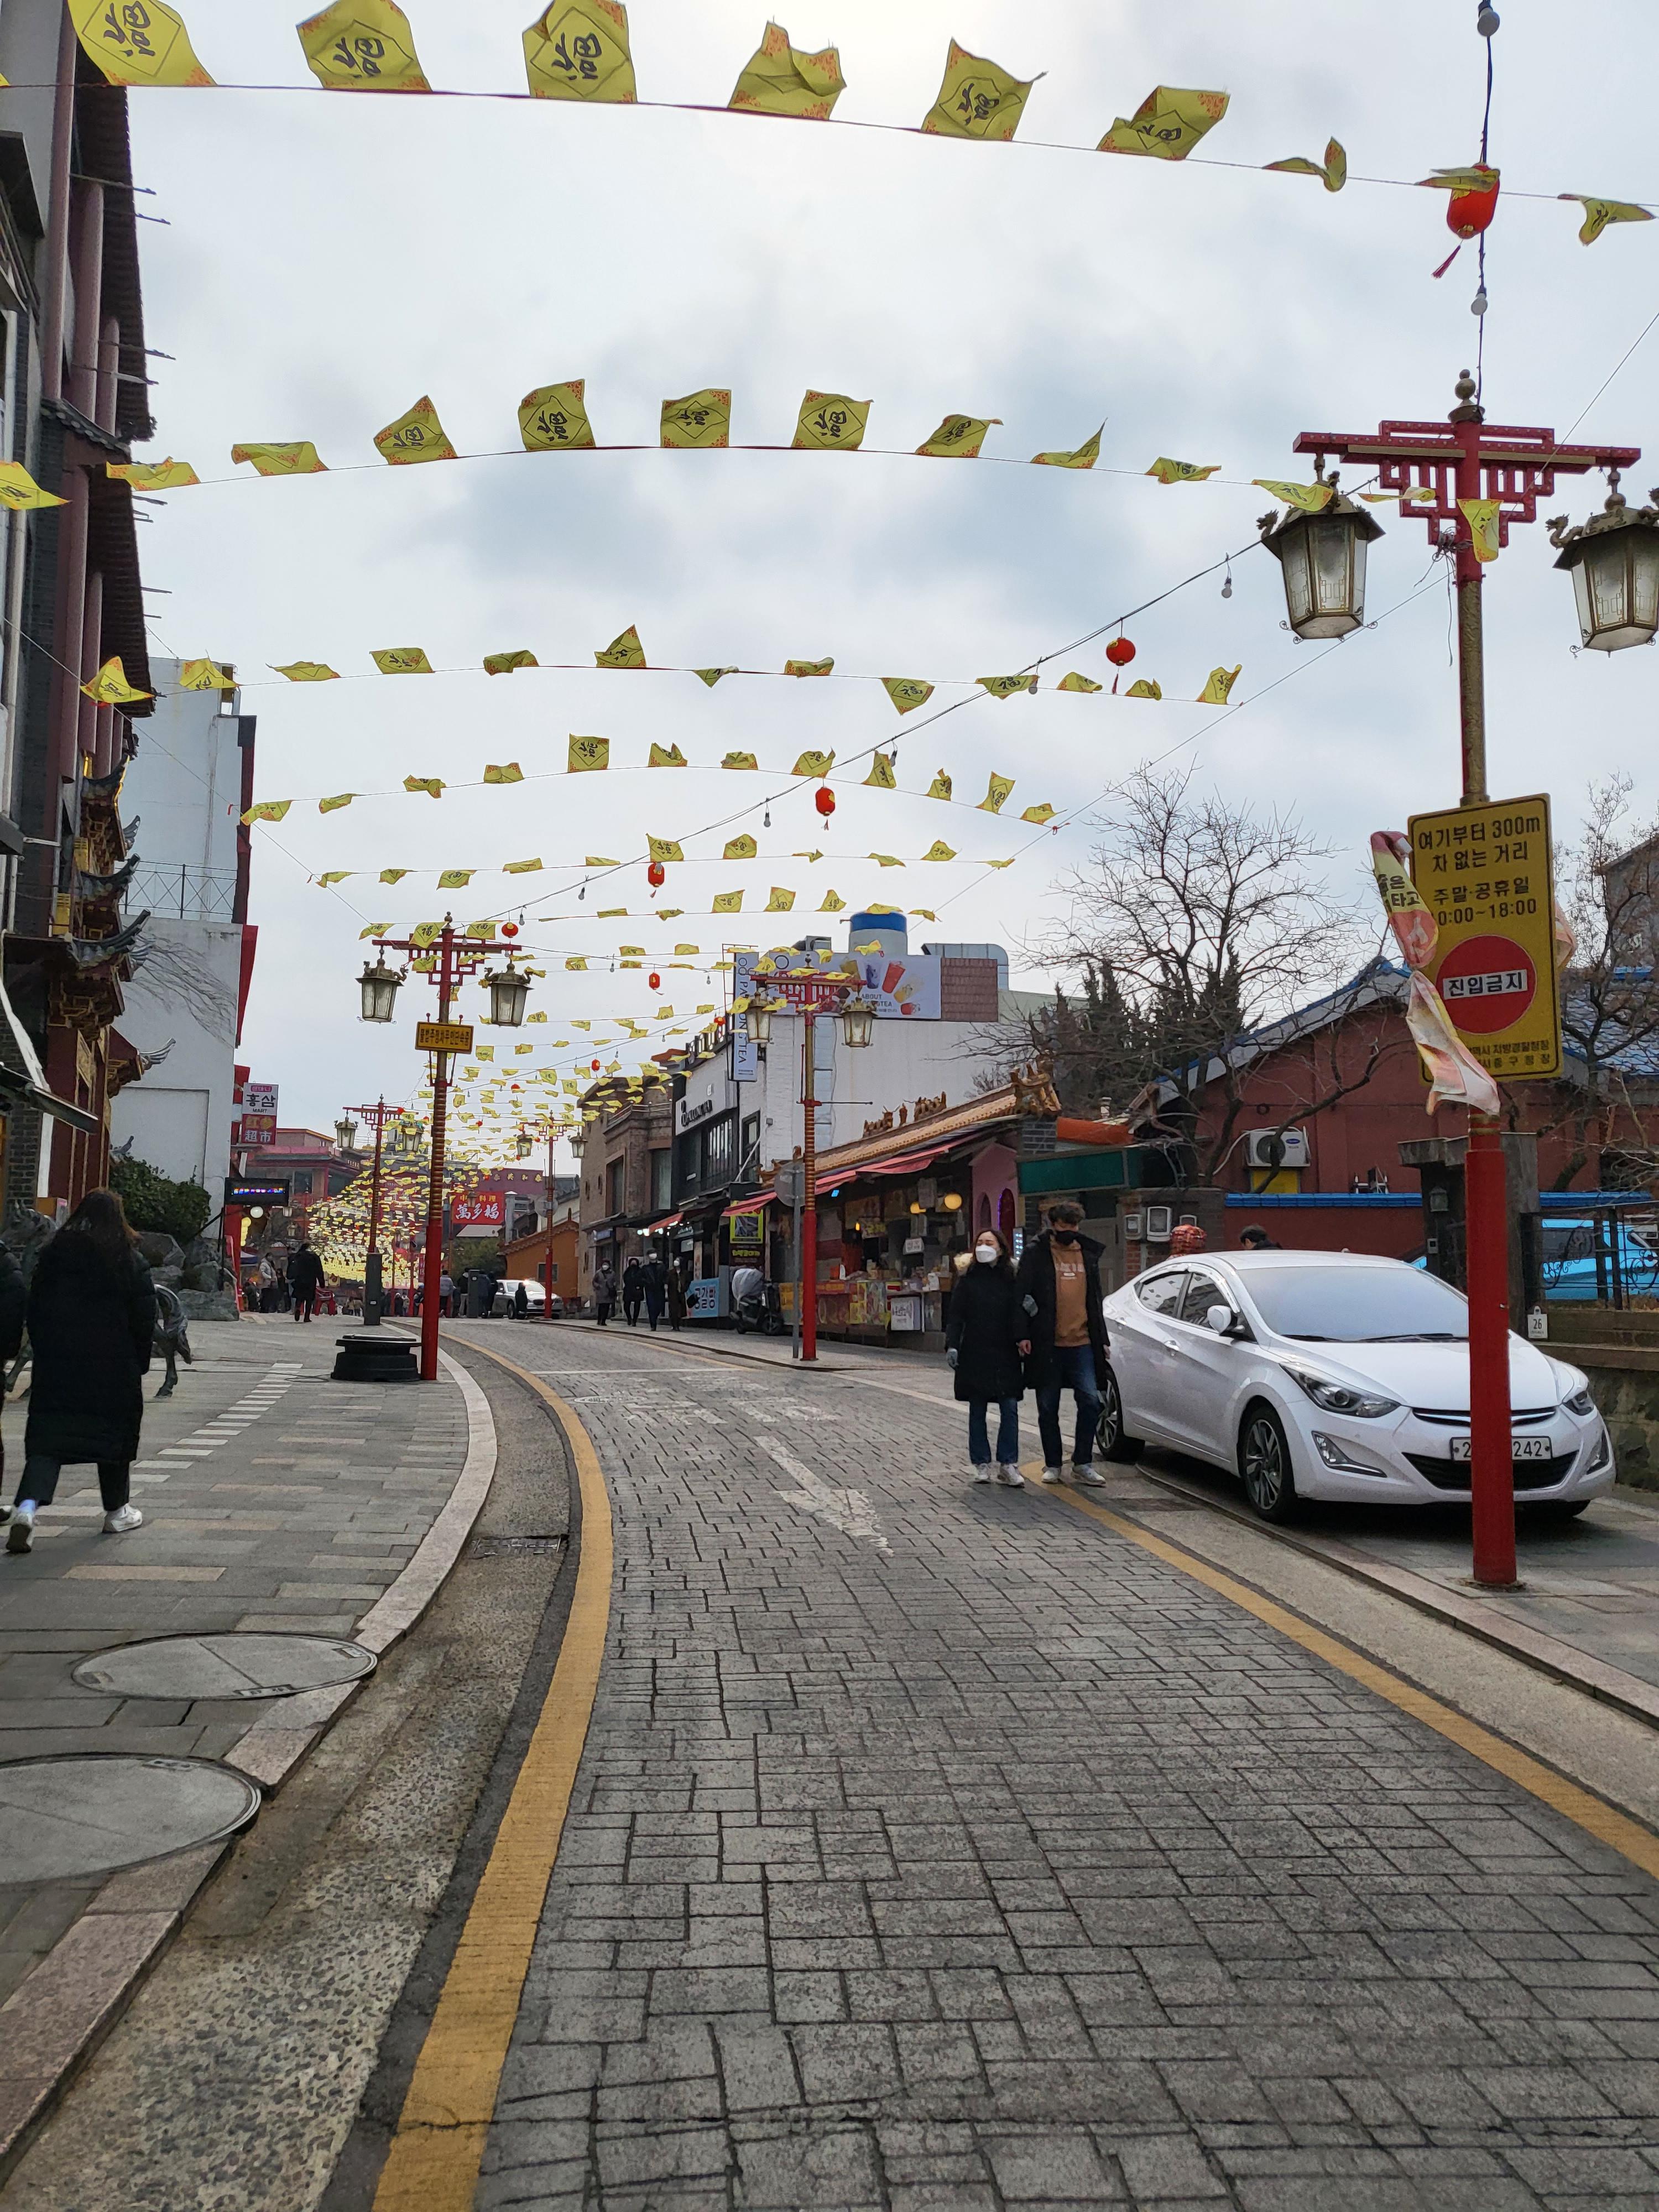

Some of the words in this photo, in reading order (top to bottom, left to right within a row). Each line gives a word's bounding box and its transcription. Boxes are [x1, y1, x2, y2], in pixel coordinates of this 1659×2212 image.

[1418, 822, 1485, 850] 여기부터
[1492, 816, 1540, 839] 300m
[1432, 853, 1447, 872] 차
[1454, 848, 1487, 870] 없는
[1494, 841, 1528, 863] 거리
[1433, 898, 1537, 926] 0:00~18:00
[1448, 969, 1524, 997] 진입금지
[738, 1041, 748, 1063] TEA
[246, 1093, 276, 1108] 홍삼
[460, 1194, 496, 1202] 中料理
[455, 1202, 499, 1220] 萬多福
[1533, 1318, 1542, 1329] 26
[1512, 1440, 1543, 1457] 242
